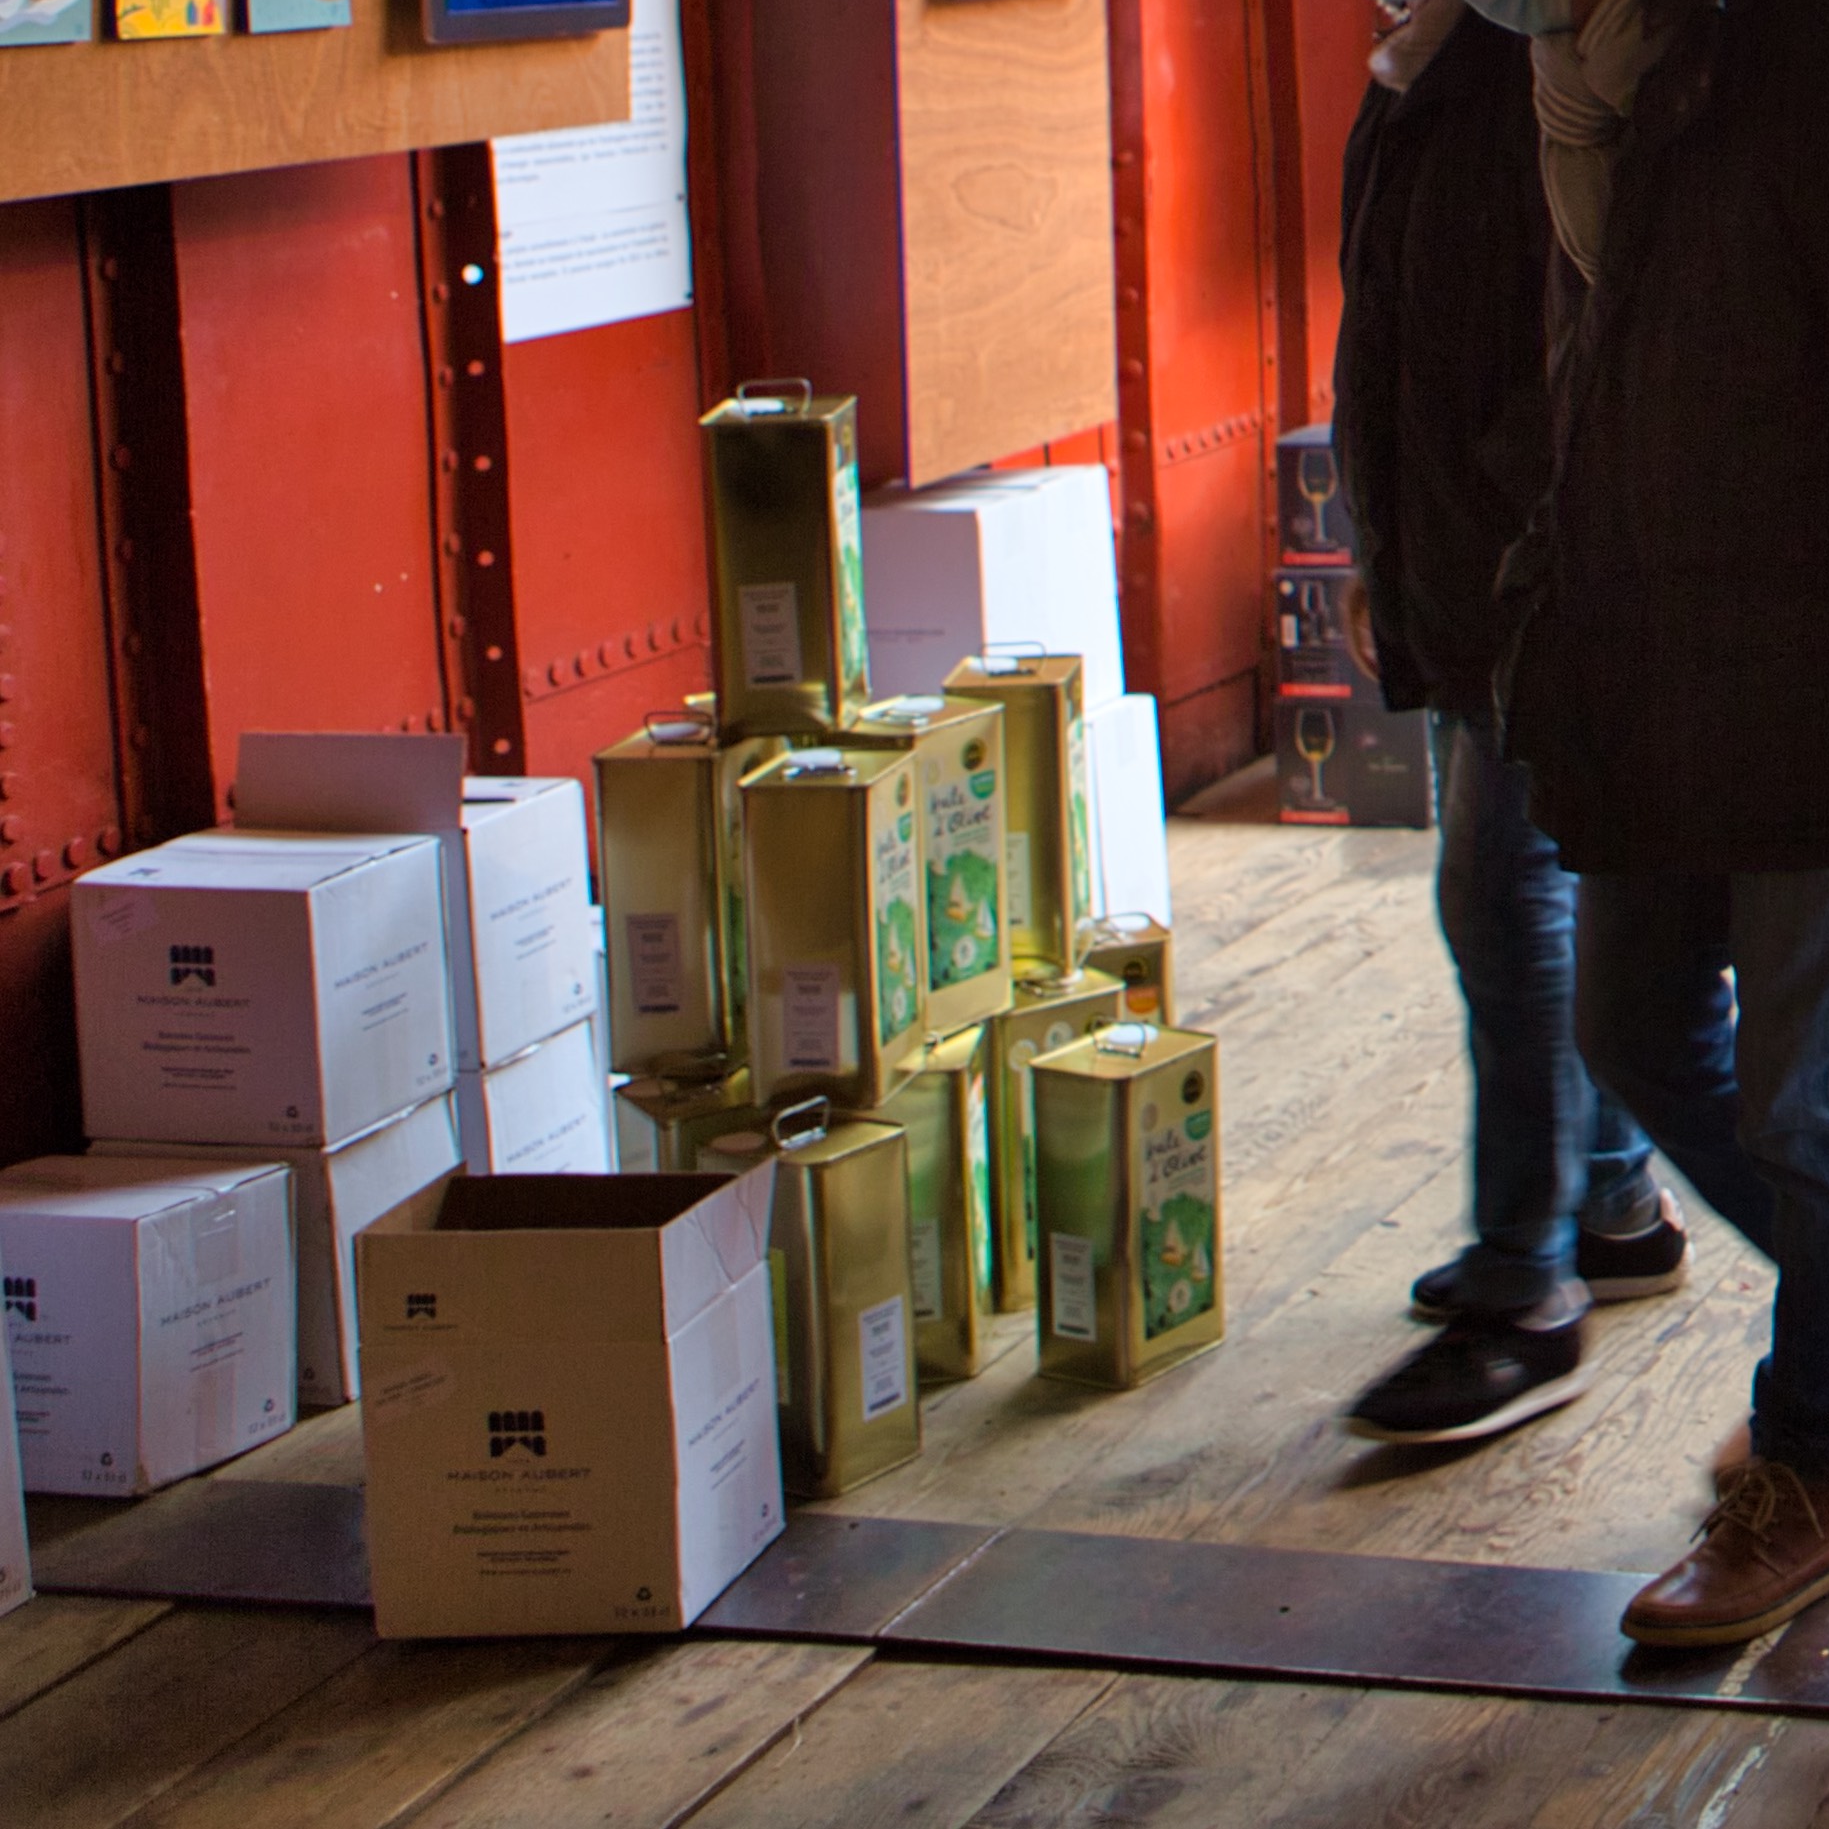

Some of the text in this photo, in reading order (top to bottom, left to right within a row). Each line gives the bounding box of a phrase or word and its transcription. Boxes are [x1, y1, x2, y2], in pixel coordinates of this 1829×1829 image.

[160, 1276, 272, 1328] MAISON AUBERT
[15, 1333, 72, 1345] AUBERT
[447, 1467, 592, 1481] MAISON AUBERT
